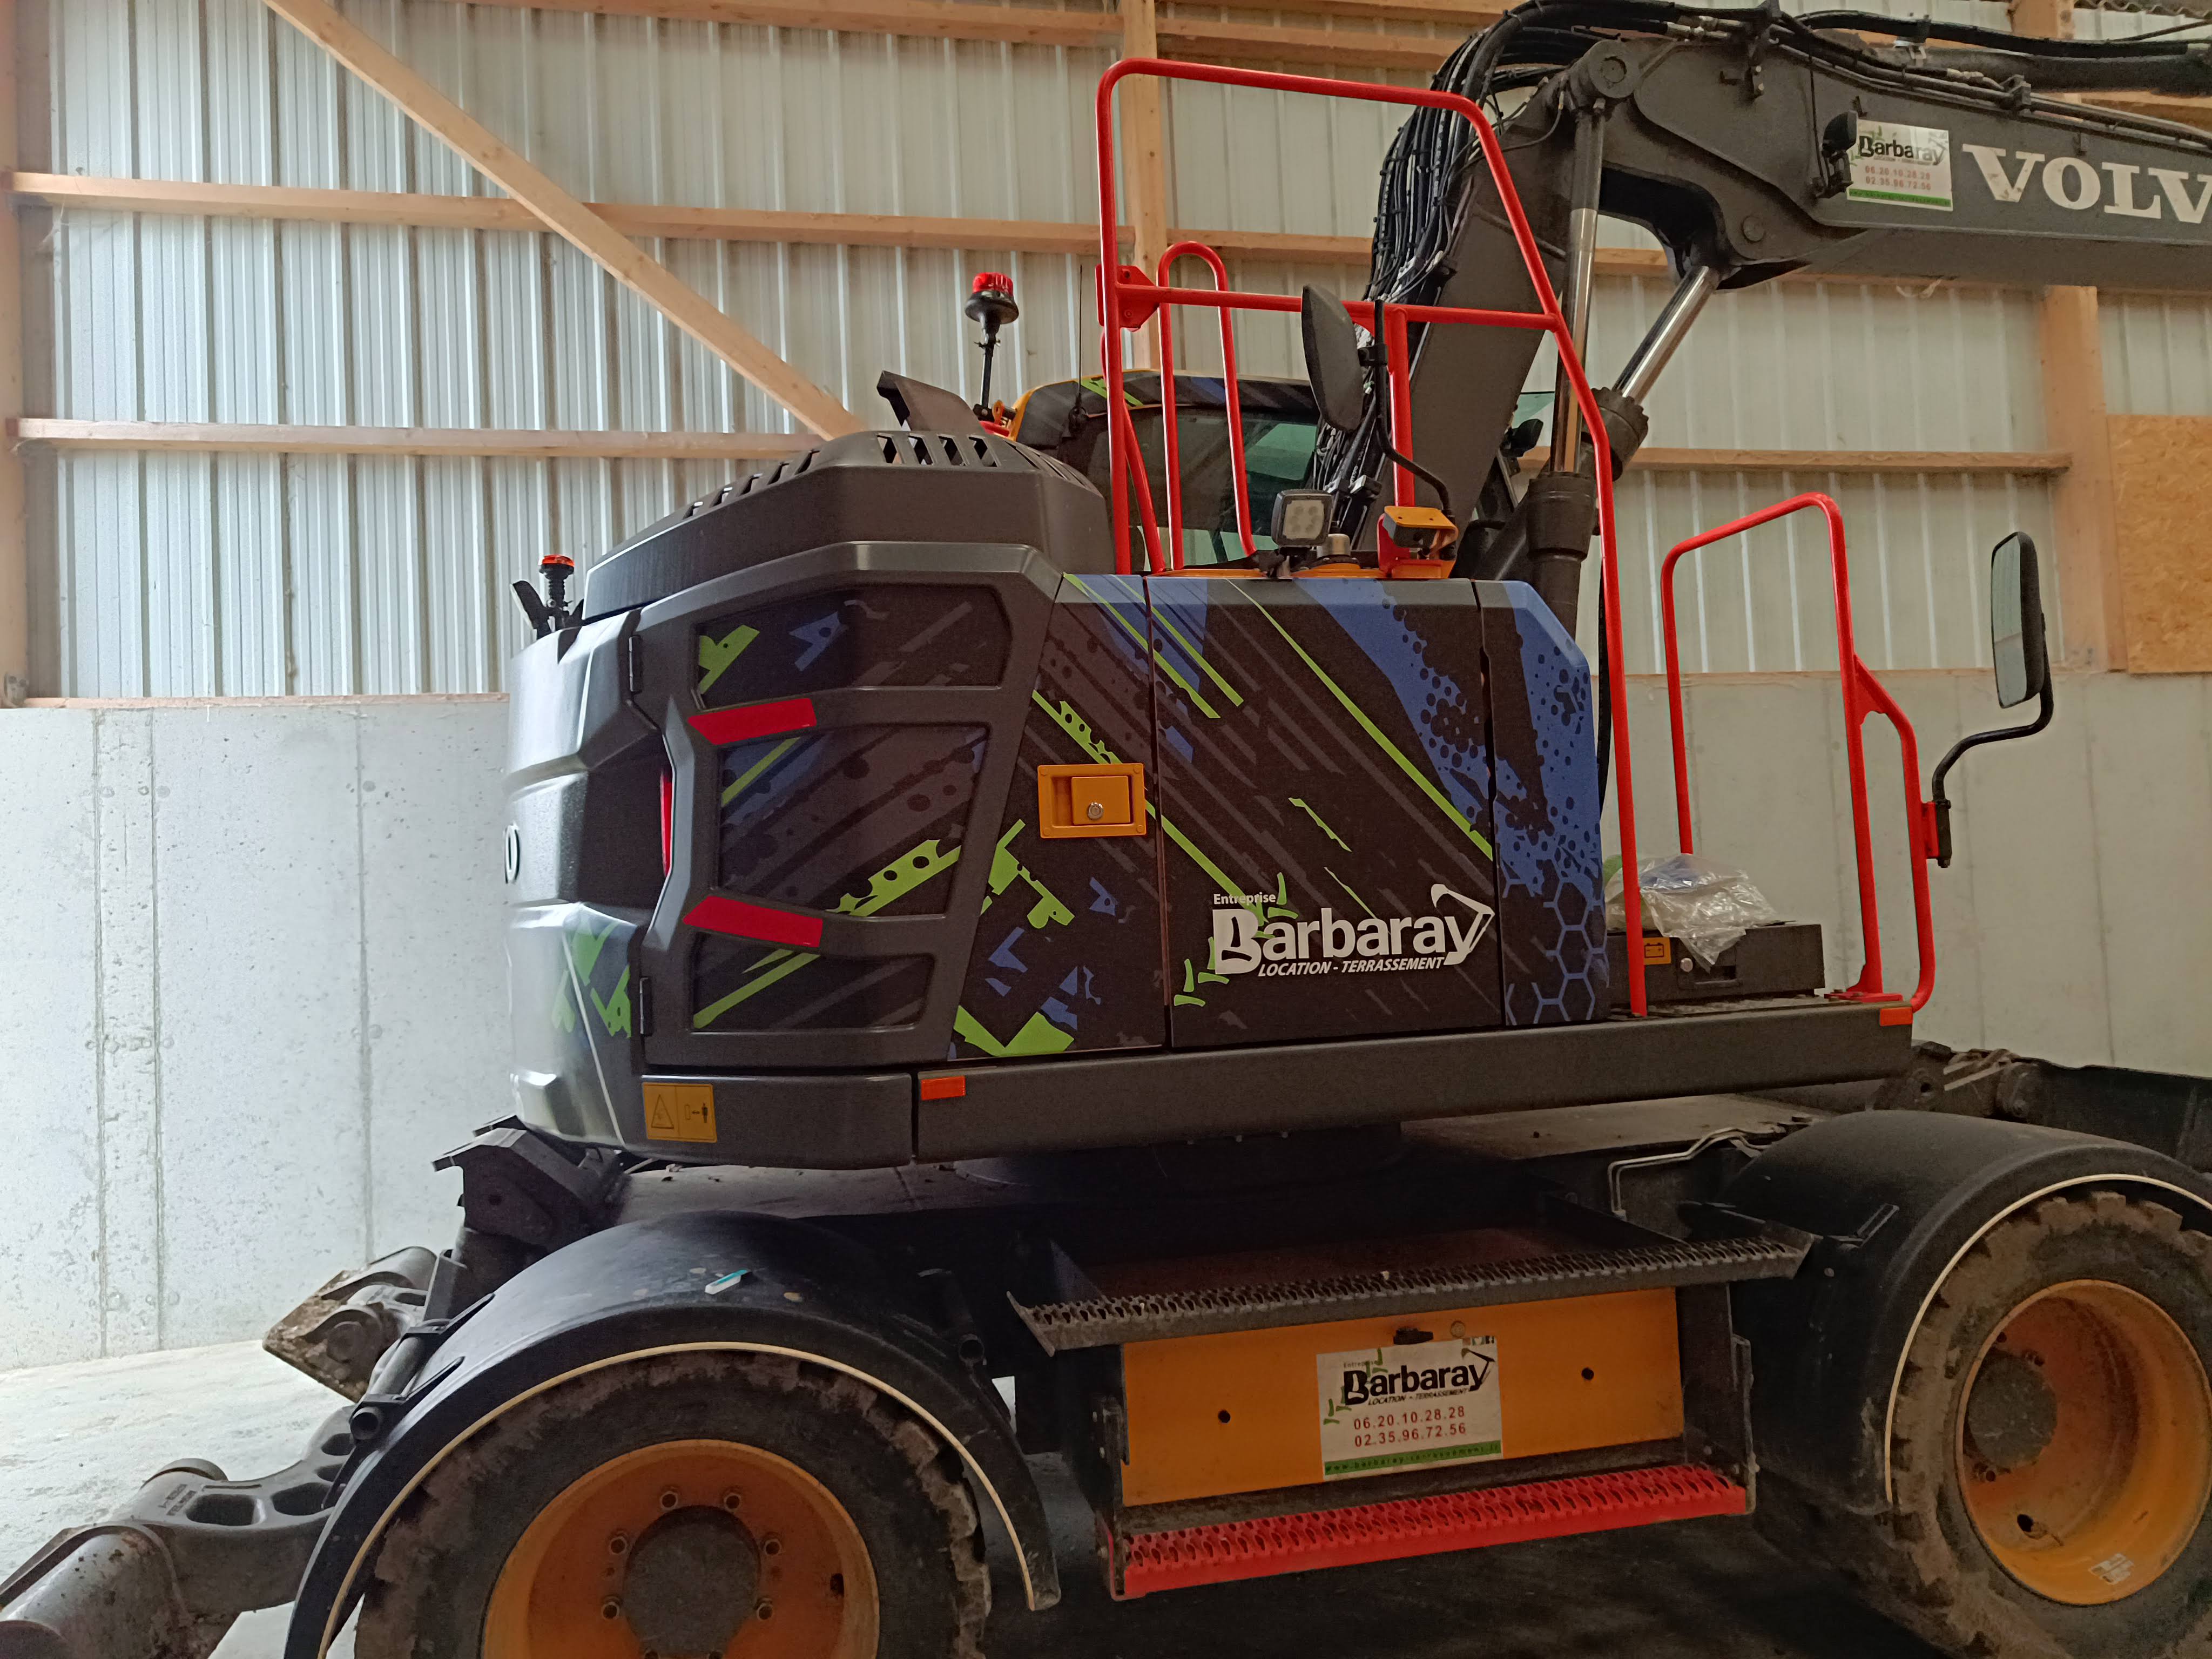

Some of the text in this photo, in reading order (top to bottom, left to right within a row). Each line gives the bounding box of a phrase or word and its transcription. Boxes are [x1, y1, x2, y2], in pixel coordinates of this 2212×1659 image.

[1859, 135, 1946, 166] Barbaray
[1865, 165, 1931, 180] 06.20.10.28.28
[1865, 176, 1932, 191] 02.35.96.72.56
[1213, 892, 1277, 906] Entreprise
[1212, 907, 1495, 975] Barbaray
[1258, 960, 1331, 977] LOCATION
[1341, 956, 1445, 973] TERRASSEMENT
[1344, 1358, 1494, 1405] Barbaray
[1368, 1394, 1406, 1406] LOCATION
[1354, 1406, 1465, 1431] 06.20.10.28.28
[1354, 1423, 1466, 1447] 02.35.96.72.56
